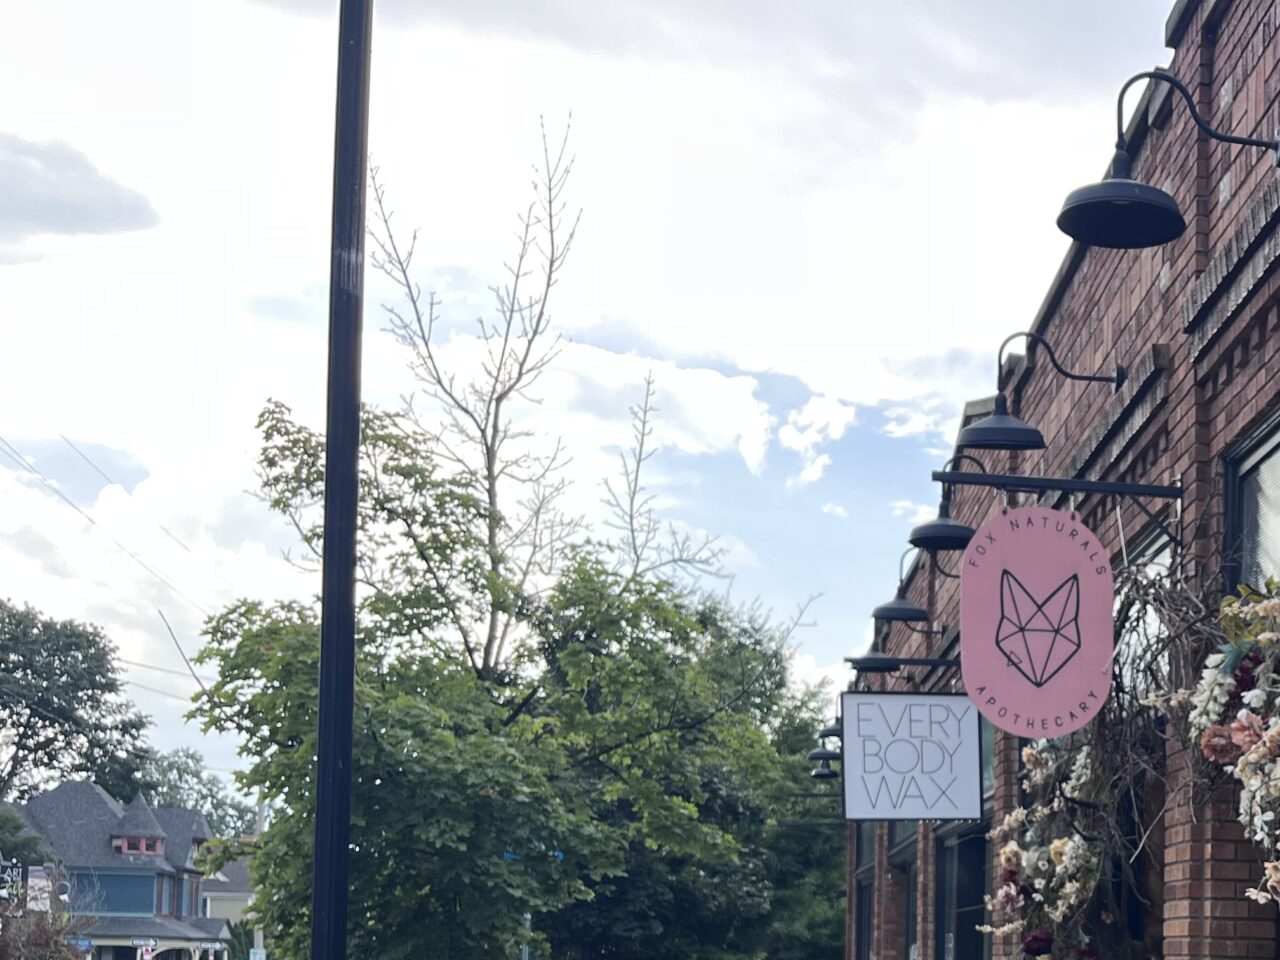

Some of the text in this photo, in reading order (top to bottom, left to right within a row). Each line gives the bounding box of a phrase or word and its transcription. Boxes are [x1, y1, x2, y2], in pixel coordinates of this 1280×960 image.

[968, 517, 1106, 576] FOX NATURALS
[856, 702, 971, 739] EVERY
[976, 686, 1099, 730] APOTHECARY
[862, 738, 964, 775] BODY
[861, 774, 959, 810] WAX
